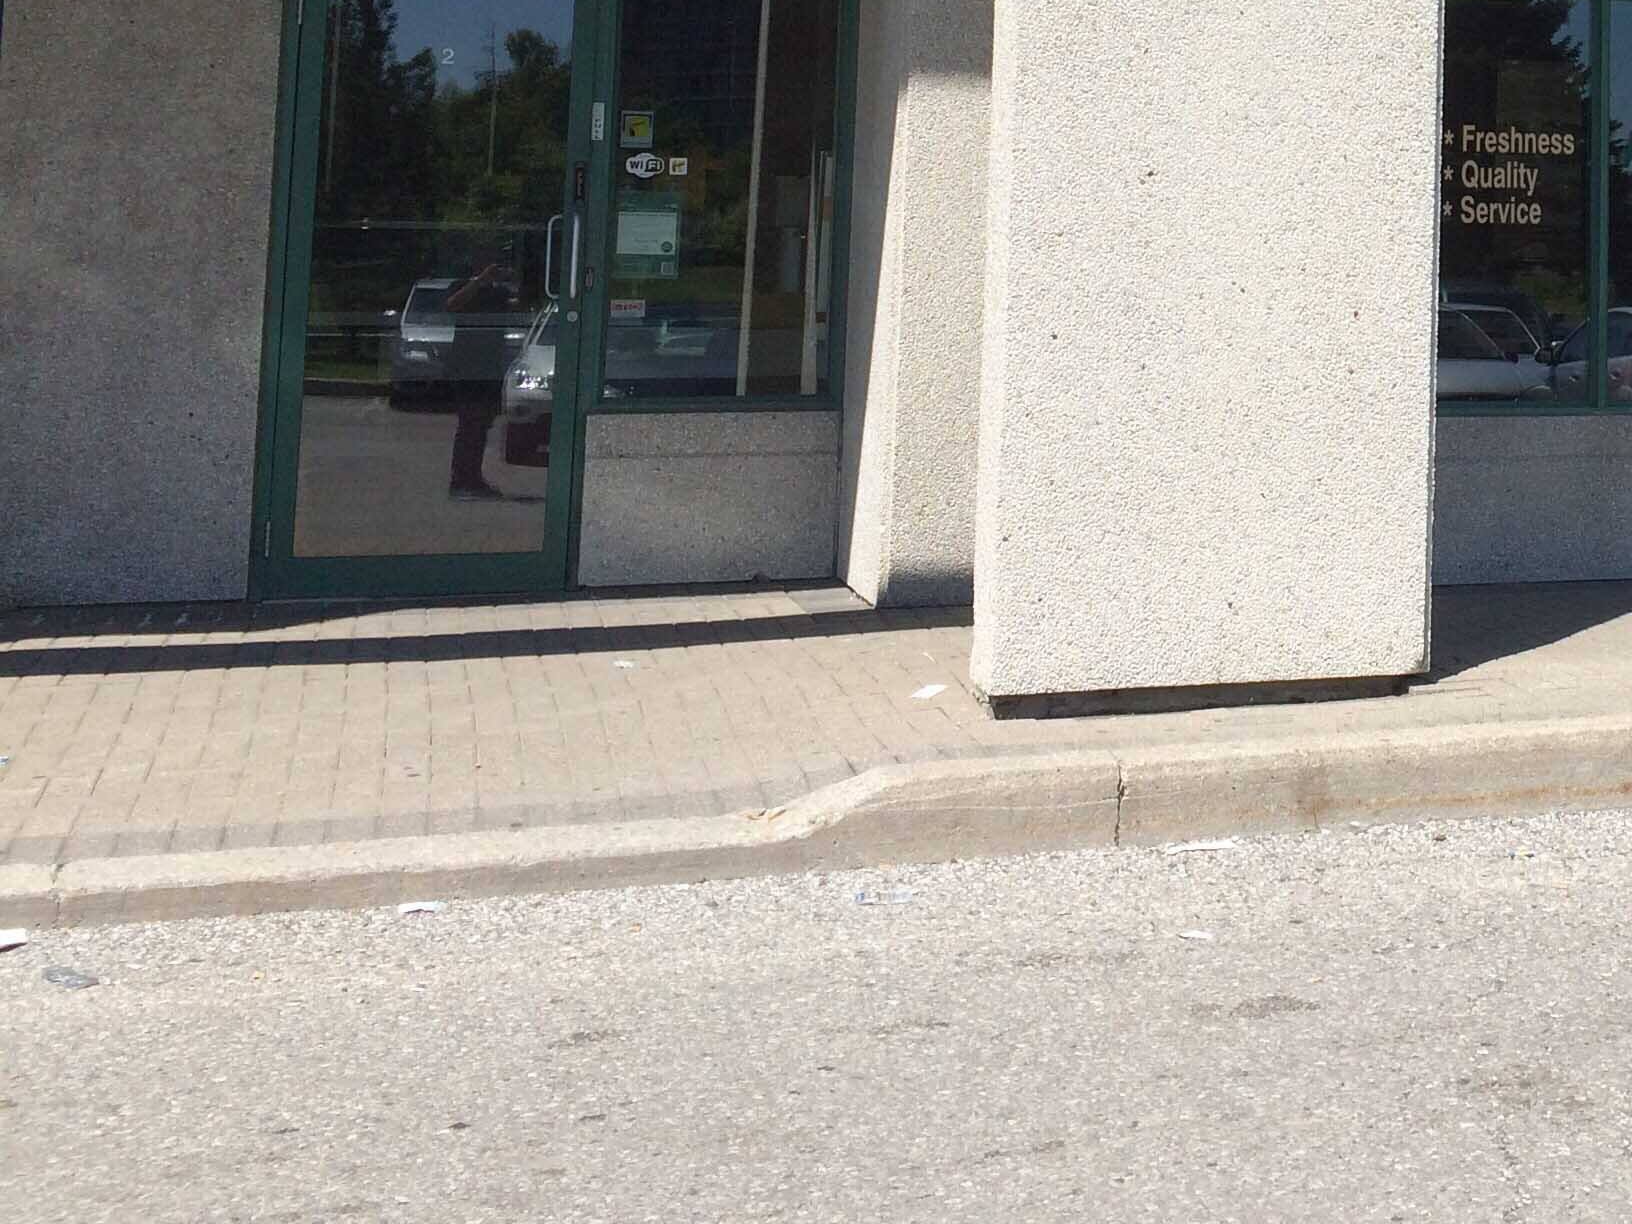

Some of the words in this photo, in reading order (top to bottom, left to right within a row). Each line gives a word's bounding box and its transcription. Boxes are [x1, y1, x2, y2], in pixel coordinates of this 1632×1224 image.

[440, 47, 456, 65] 2
[1461, 124, 1575, 155] Freshness
[1460, 159, 1539, 197] Quality
[1460, 194, 1542, 225] Service
